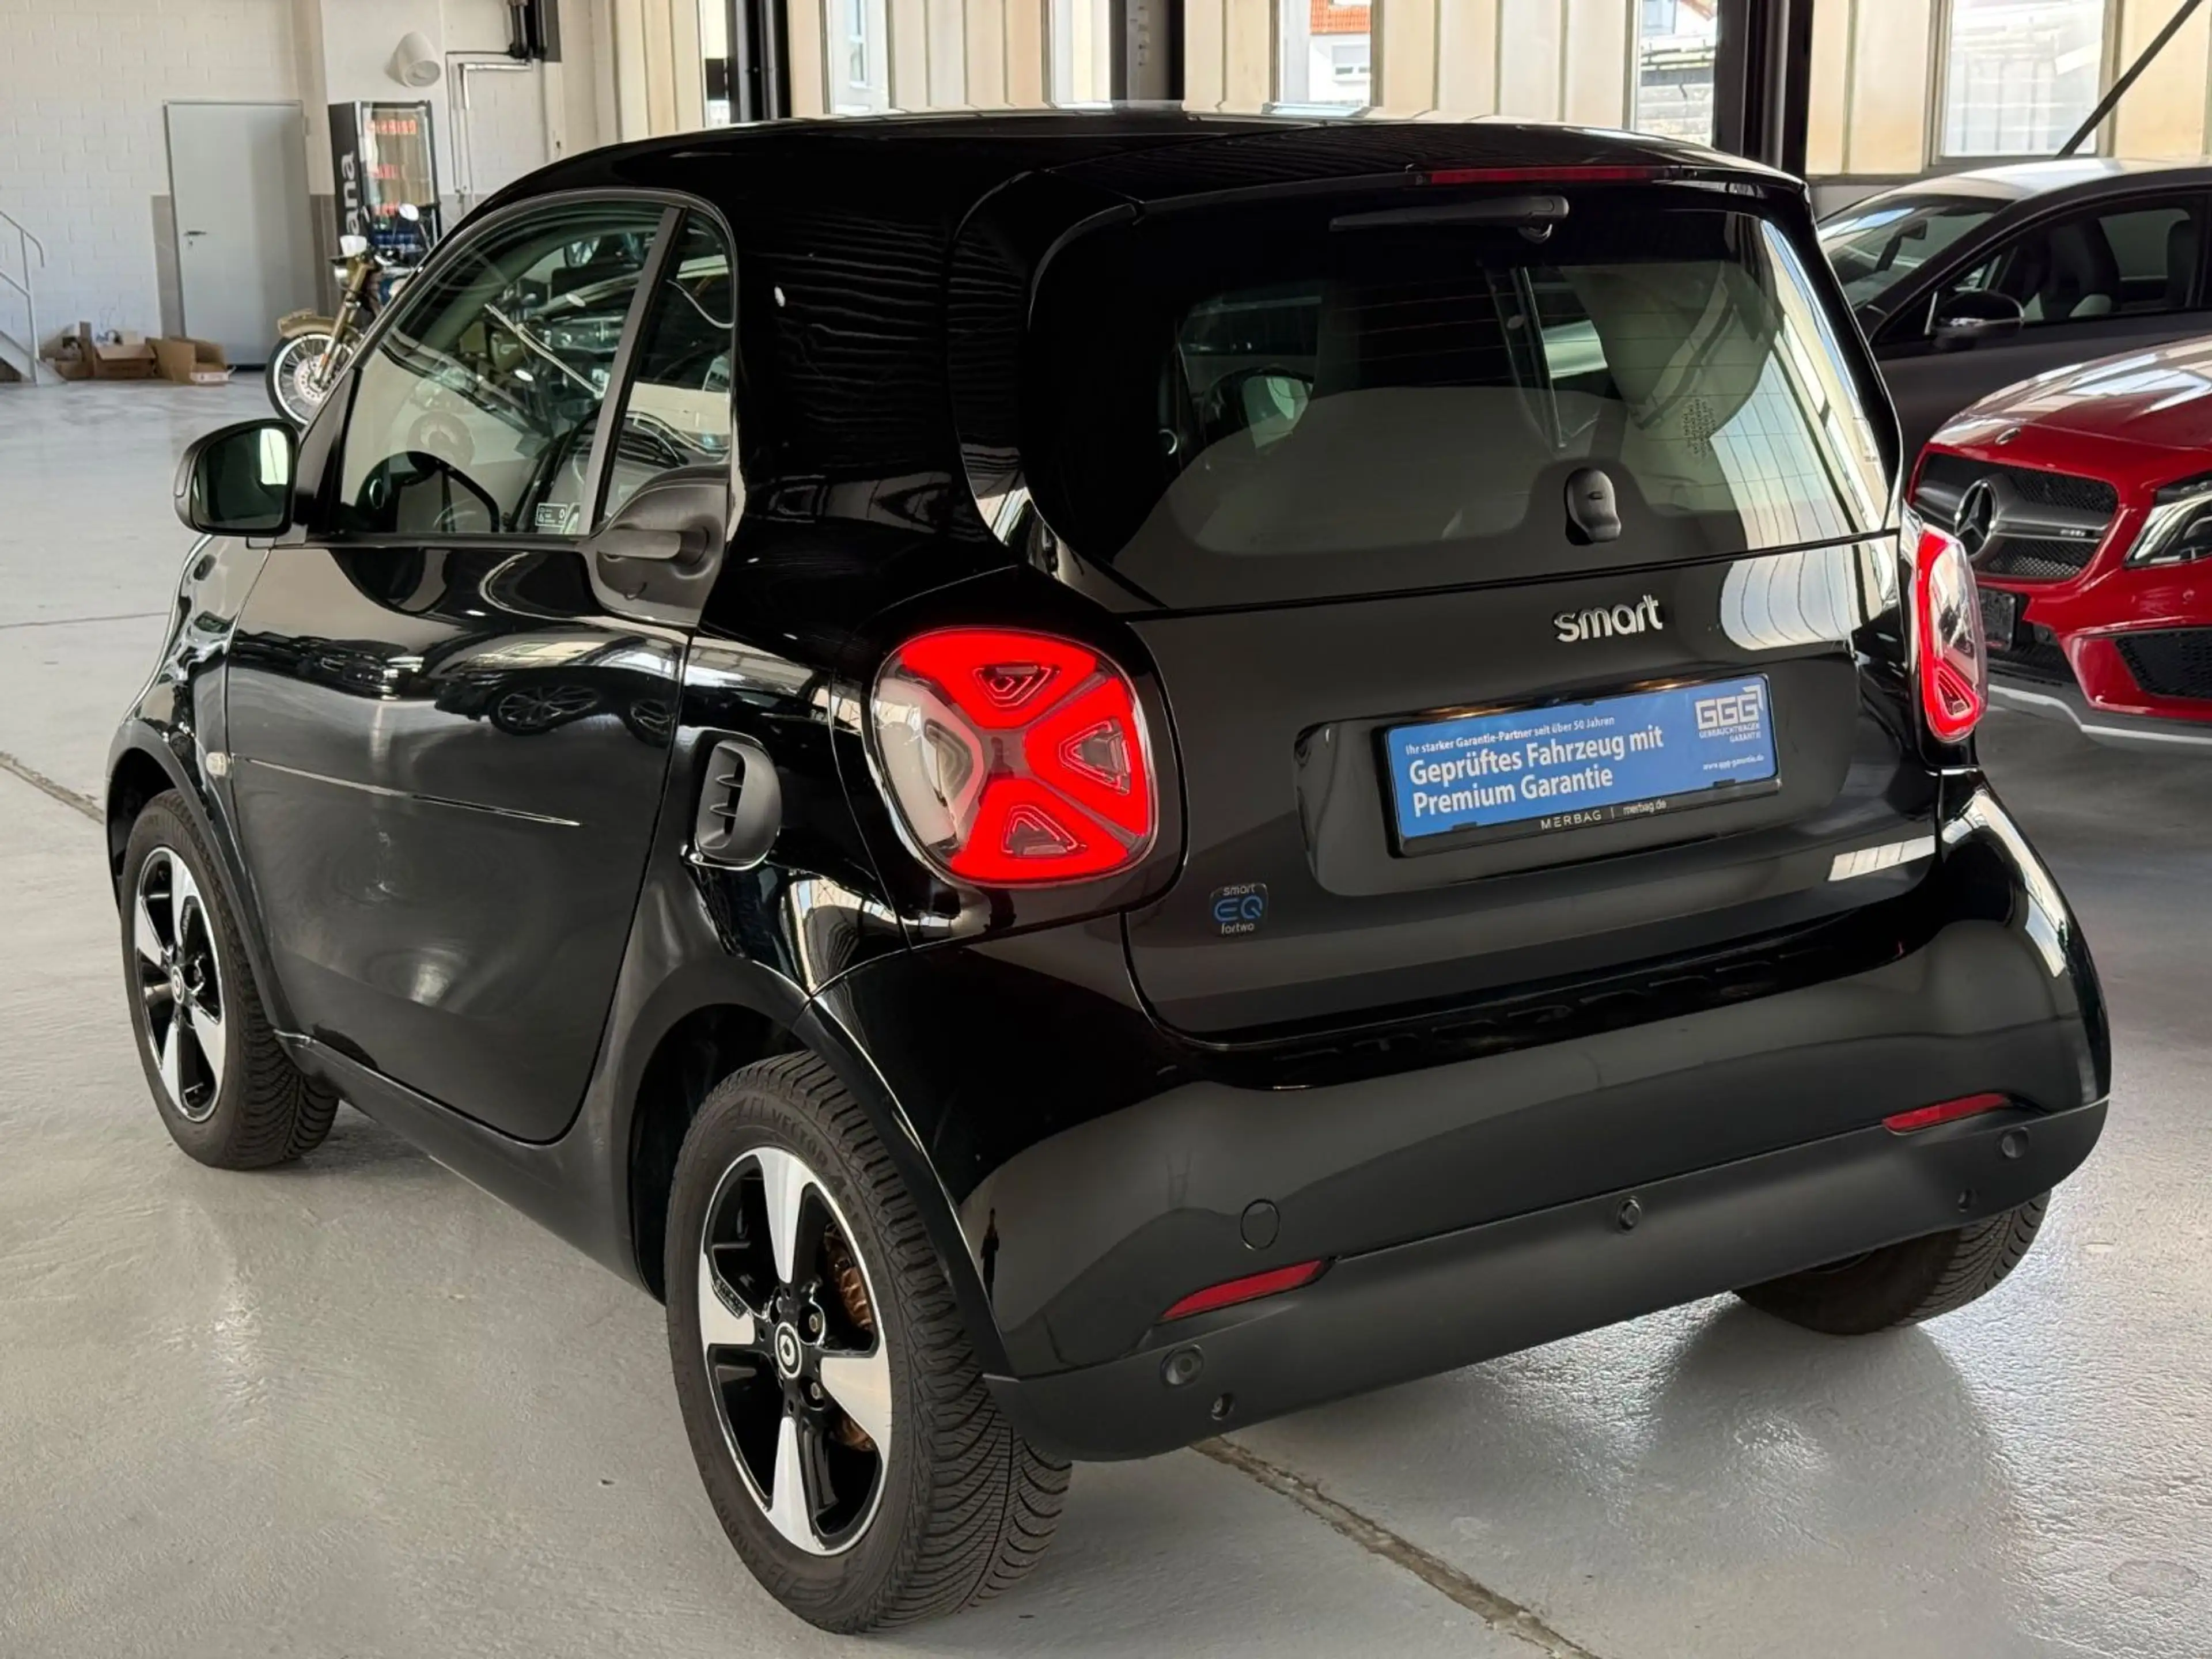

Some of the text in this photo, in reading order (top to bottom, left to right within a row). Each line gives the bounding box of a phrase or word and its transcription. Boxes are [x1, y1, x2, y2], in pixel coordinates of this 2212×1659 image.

[342, 151, 360, 235] ana
[1554, 594, 1664, 642] smart
[1695, 691, 1759, 730] GGG
[1406, 716, 1615, 755] Ihr starker Garantie-Partner seit über 50 Jahren
[1410, 724, 1664, 787] Geprüftes Fahrzeug mit
[1413, 763, 1613, 818] Premium Garantie
[1541, 809, 1603, 830] MERBAG
[1214, 895, 1263, 922] EQ
[1223, 882, 1255, 896] smart
[1221, 922, 1254, 935] fortwo
